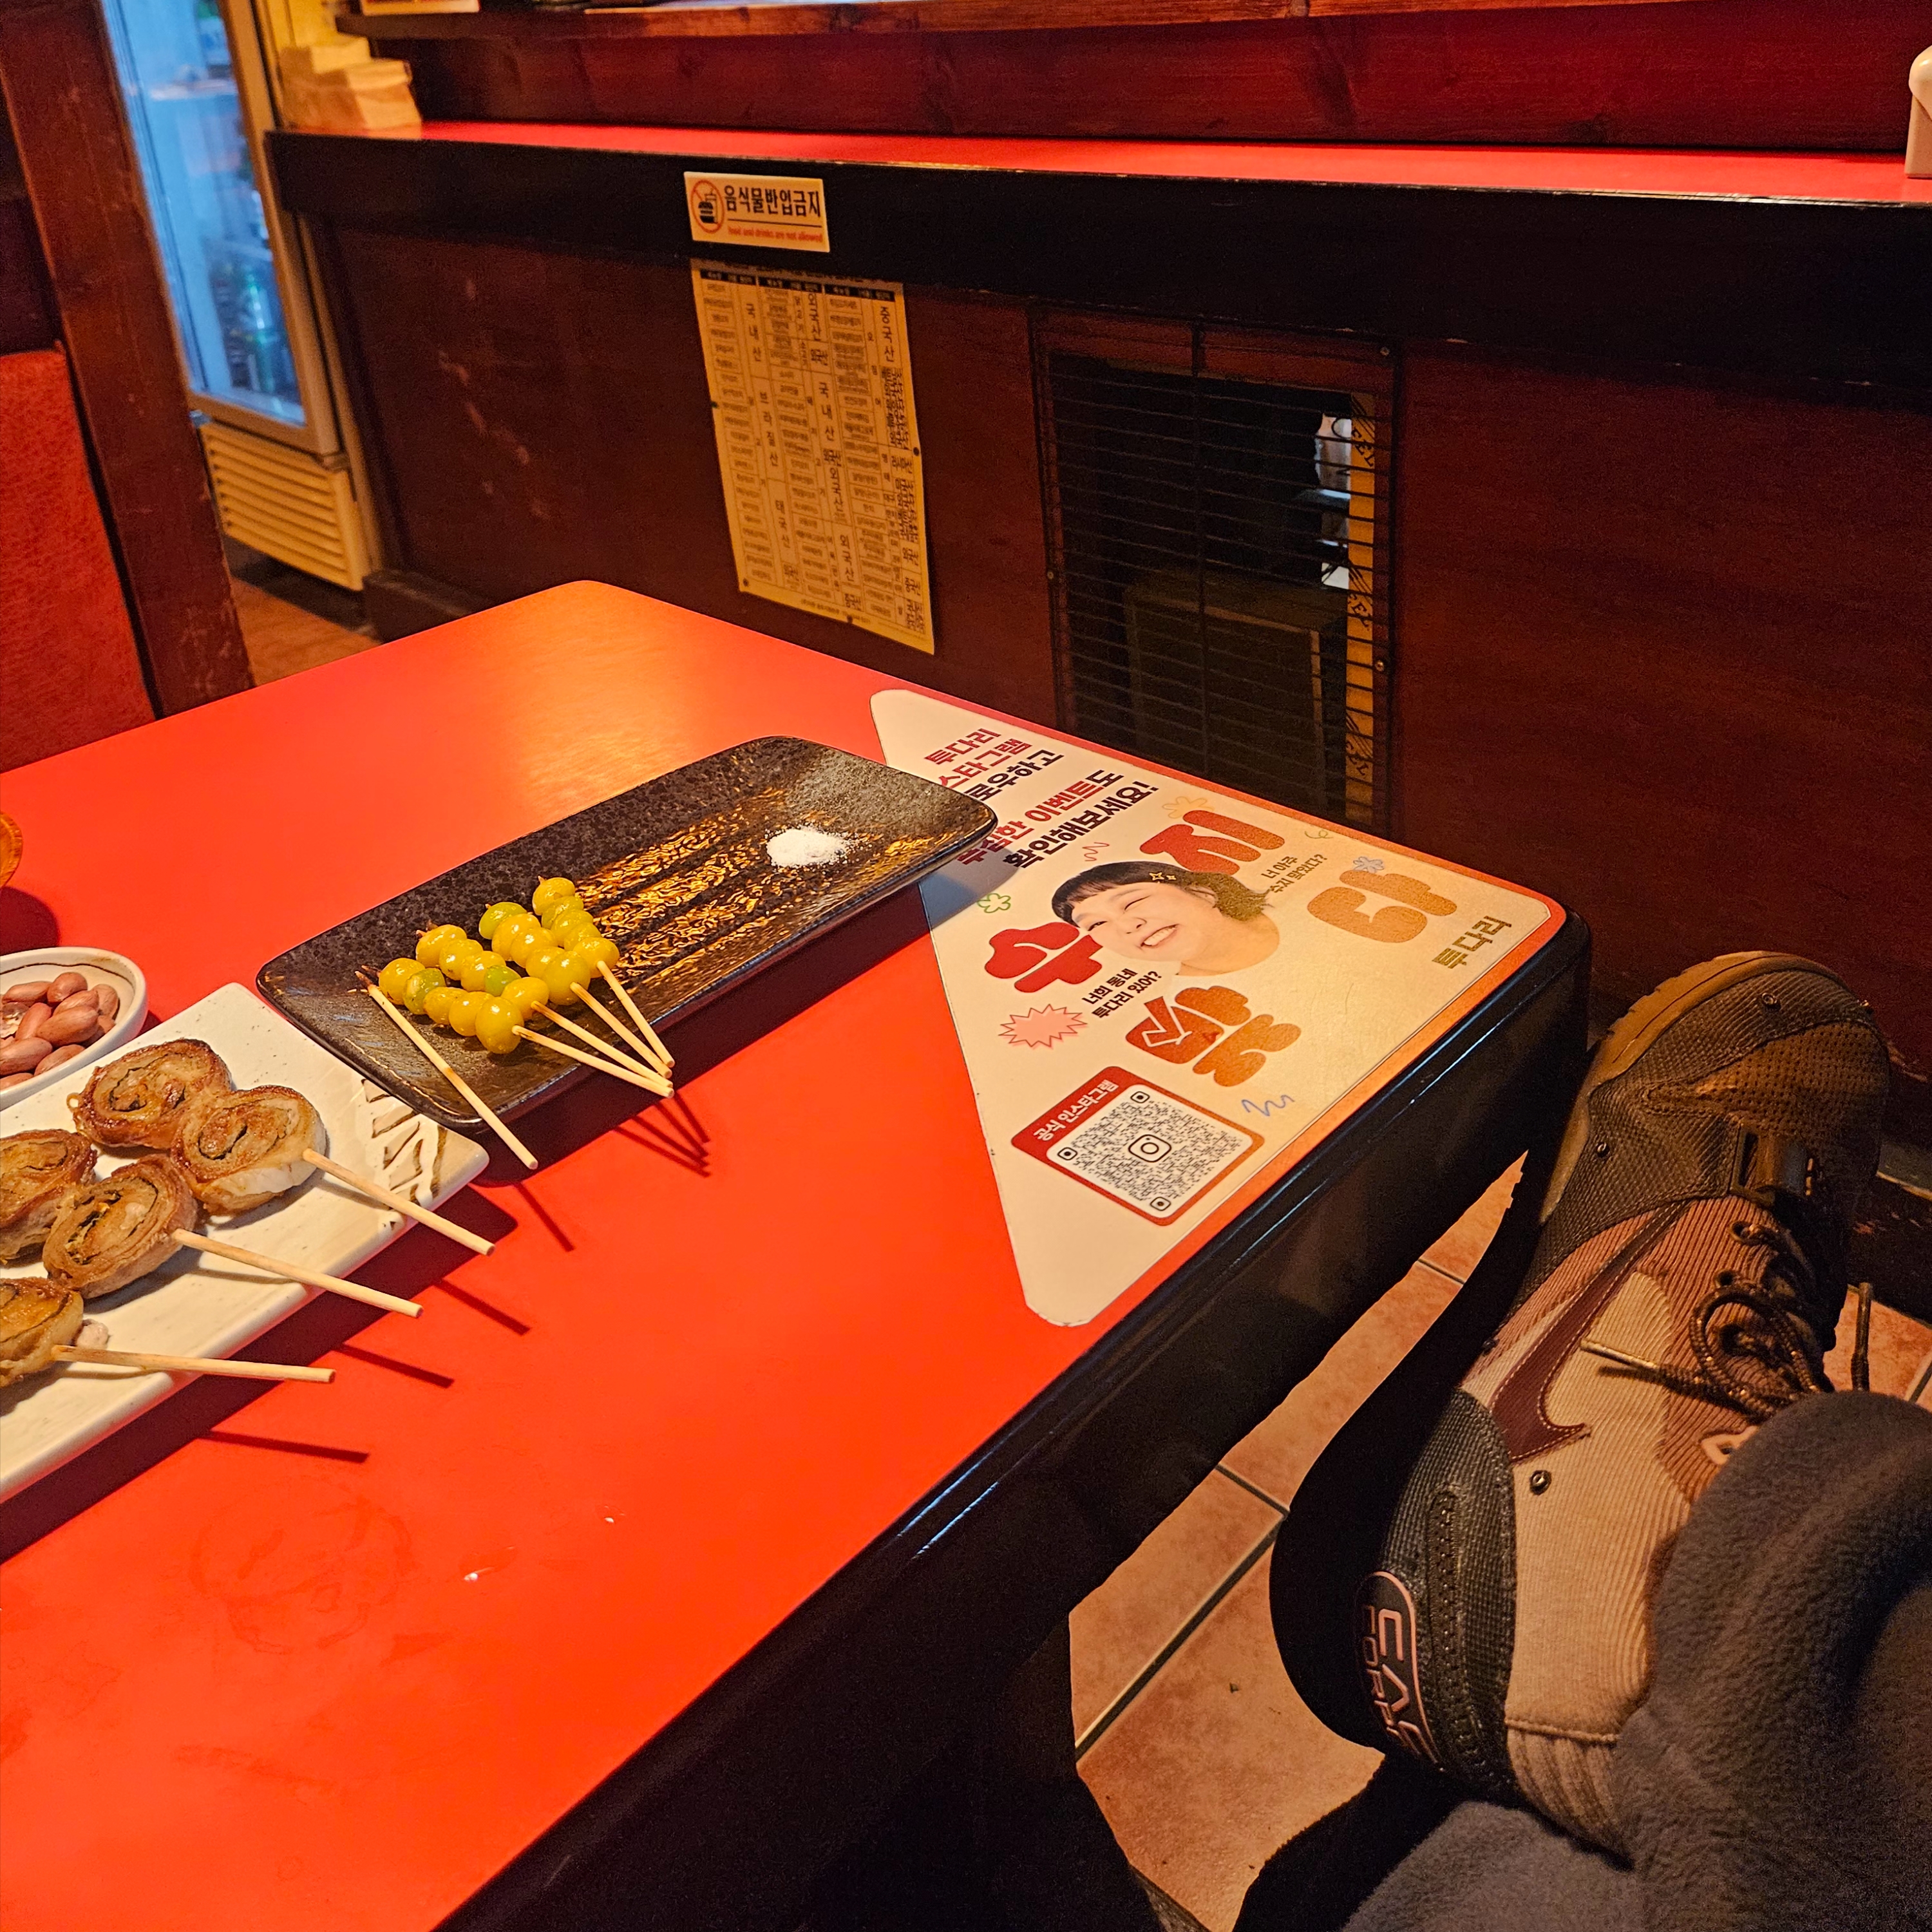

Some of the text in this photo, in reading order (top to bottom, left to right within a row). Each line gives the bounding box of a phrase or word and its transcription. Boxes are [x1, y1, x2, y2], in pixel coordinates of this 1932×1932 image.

[724, 185, 820, 218] 음식물반입금지
[880, 306, 895, 363] 중국산
[923, 728, 1001, 765] 투다리
[938, 738, 1032, 789] 스타그램
[963, 749, 1065, 802] 로우하고
[1025, 770, 1124, 822] 이벤트도
[1003, 781, 1159, 868] 확인해보세요!
[1261, 856, 1298, 878] 너 아주
[1286, 854, 1327, 880] 맞았다?
[1432, 916, 1512, 969] 투다리
[1081, 968, 1138, 1004] 너희 동네
[1092, 971, 1162, 1018] 투다리 있어?
[1033, 1079, 1119, 1141] 공식 인스타그램
